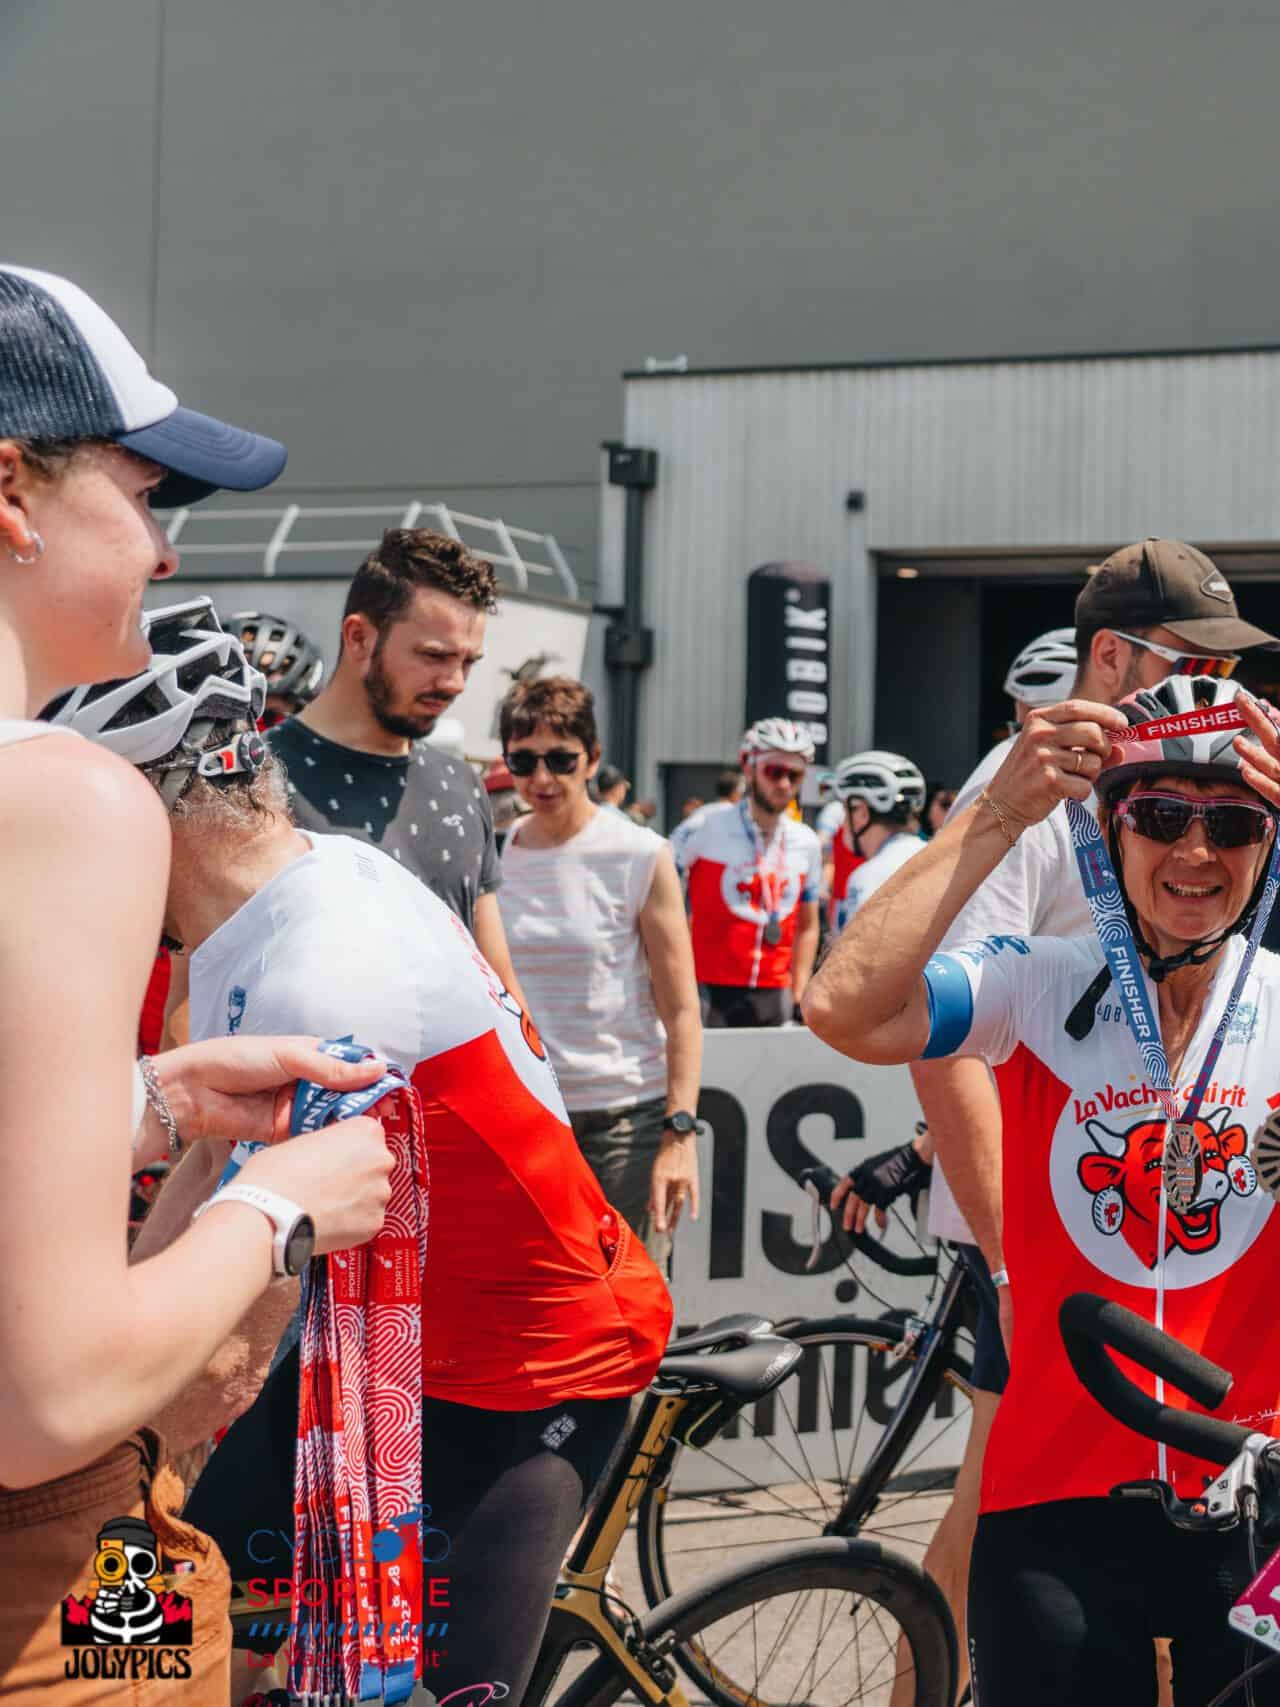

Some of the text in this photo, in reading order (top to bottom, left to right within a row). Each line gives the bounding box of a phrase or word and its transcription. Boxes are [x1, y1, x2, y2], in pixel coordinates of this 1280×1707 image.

[1147, 709, 1241, 737] FINISHER
[1111, 946, 1151, 1039] FINISHER
[1074, 1098, 1098, 1125] La
[1221, 1084, 1247, 1107] rit
[667, 1083, 865, 1281] ns
[395, 1249, 403, 1296] SPORTIVE
